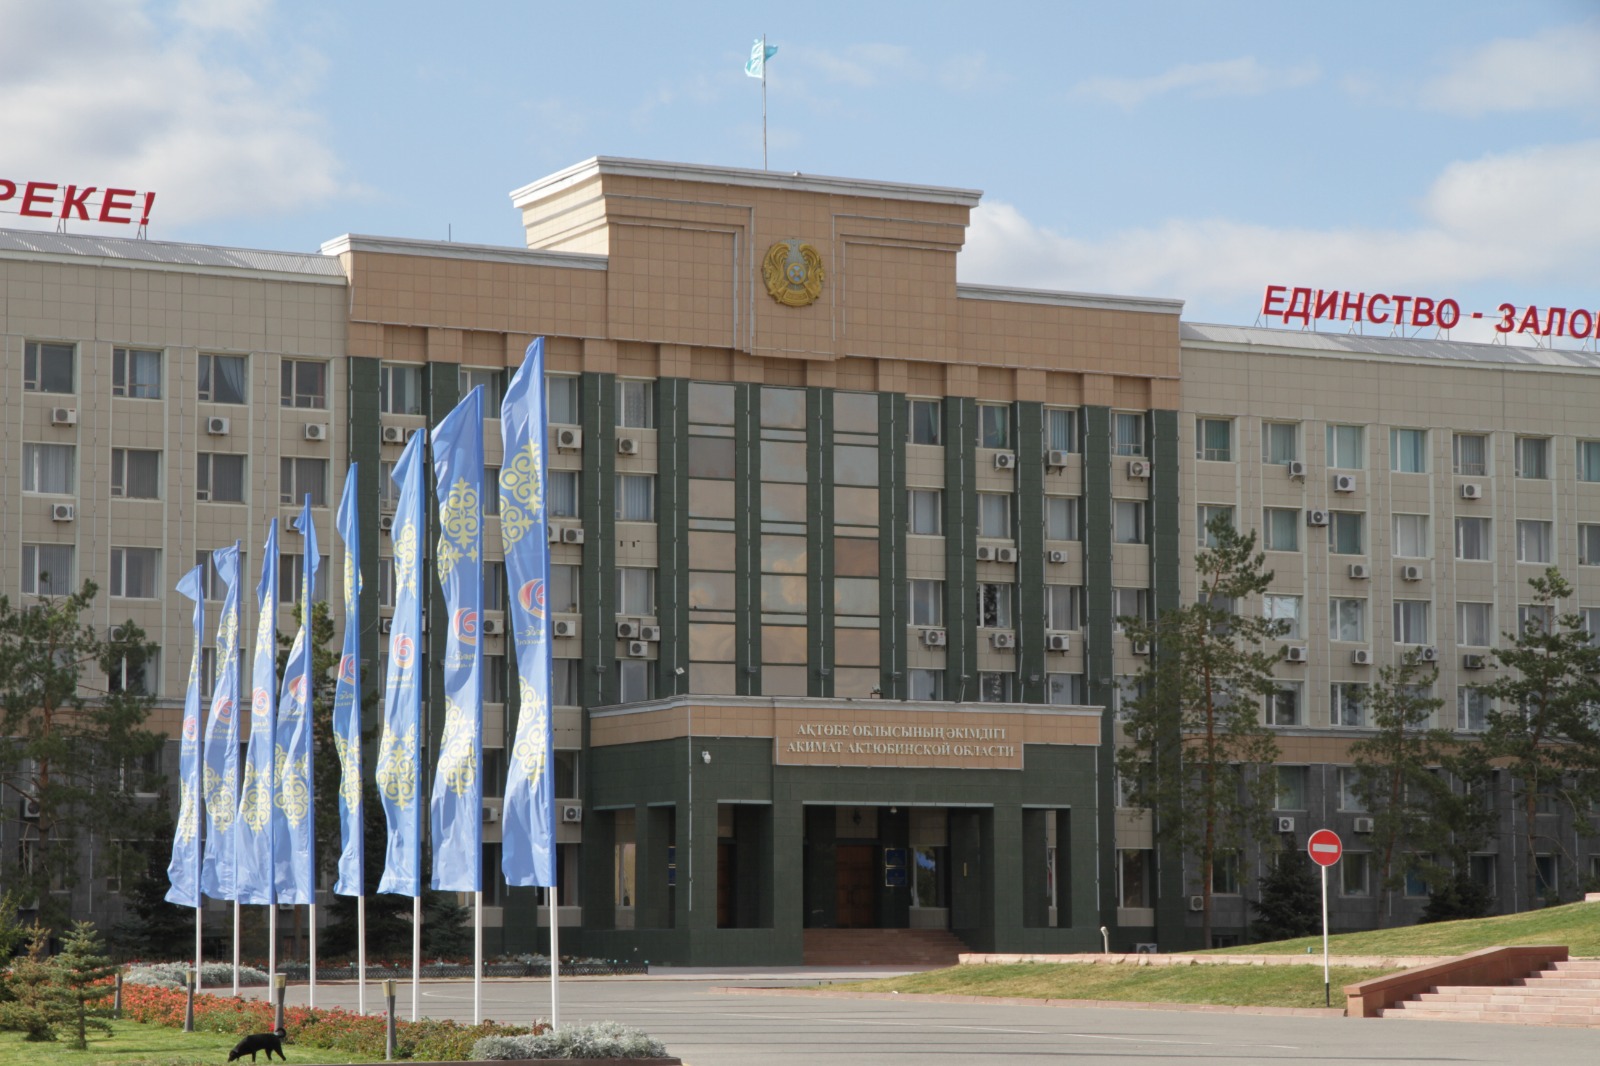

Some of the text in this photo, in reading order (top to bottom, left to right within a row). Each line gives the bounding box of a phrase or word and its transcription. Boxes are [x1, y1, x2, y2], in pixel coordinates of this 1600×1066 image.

[1262, 285, 1460, 329] ЕДИНСТВО
[1494, 303, 1600, 340] ЗАЛО
[797, 724, 1006, 741] АҚТӨБЕ ОБЛЫСЫНЫҢ ӘКІМДІГІ
[787, 741, 1014, 757] АКИМАТ АКТЮБИНСКОЙ ОБЛАСТИ
